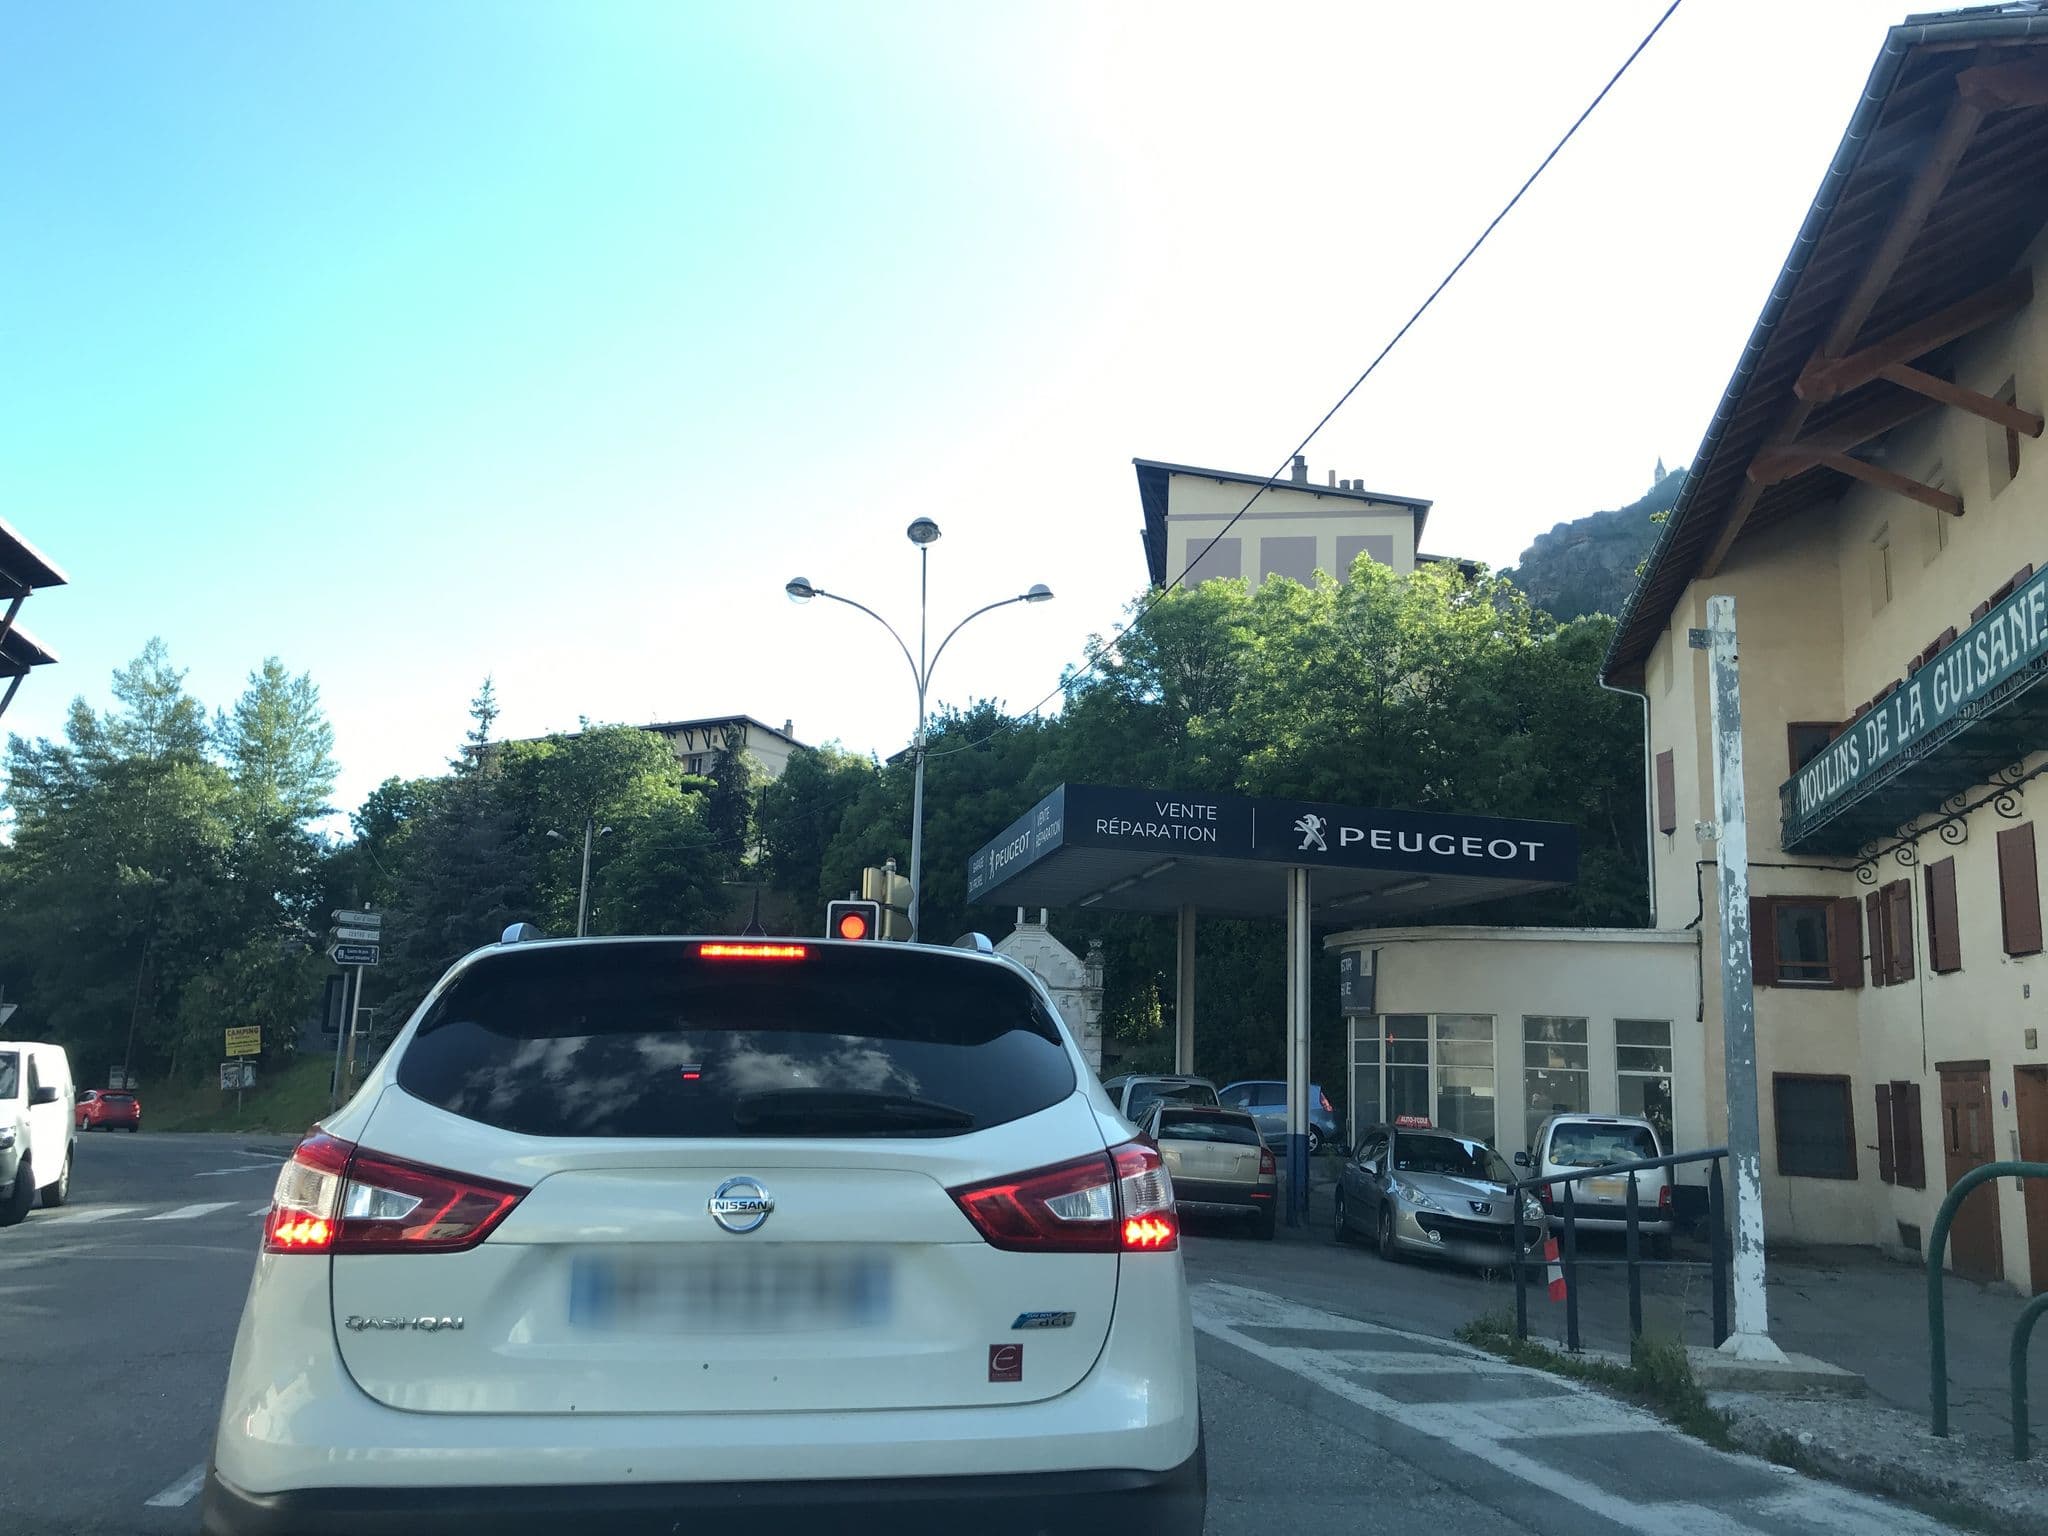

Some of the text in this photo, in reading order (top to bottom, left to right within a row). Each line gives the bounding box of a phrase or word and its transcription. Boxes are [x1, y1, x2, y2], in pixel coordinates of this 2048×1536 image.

[1798, 580, 2048, 815] MOULINS DE LA GUISANE
[1155, 800, 1218, 821] VENTE
[1096, 817, 1217, 843] RÉPARATION
[995, 830, 1031, 871] PEUGEOT
[1339, 826, 1545, 862] PEUGEOT
[227, 1027, 259, 1036] CAMPING
[715, 1200, 768, 1210] NISSAN
[345, 1314, 465, 1332] QASHQAI
